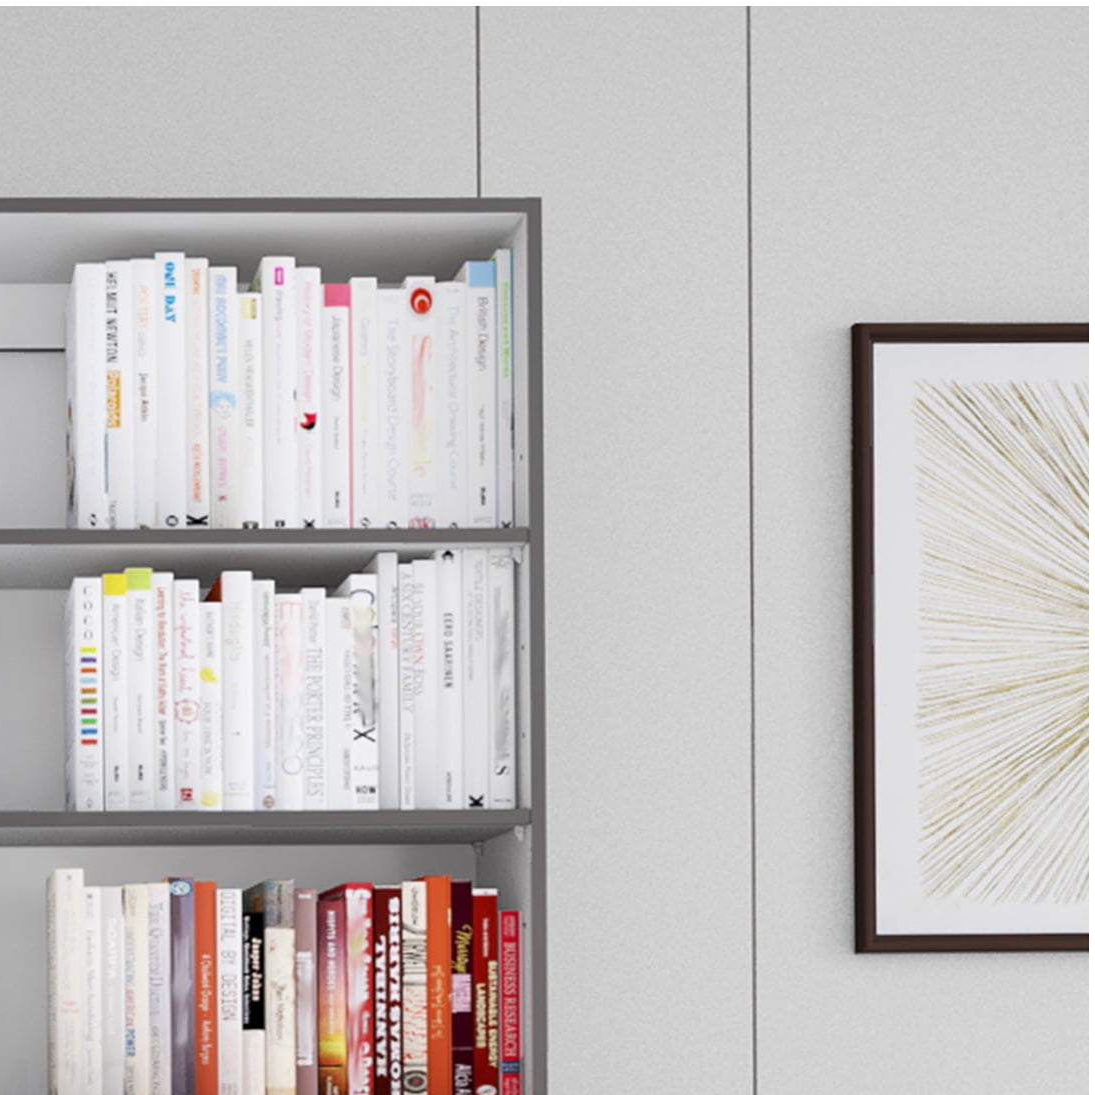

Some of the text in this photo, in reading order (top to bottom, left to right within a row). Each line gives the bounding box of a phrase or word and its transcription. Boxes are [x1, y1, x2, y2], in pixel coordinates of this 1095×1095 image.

[106, 271, 118, 363] HELMUT NEWTON
[165, 262, 176, 323] ONE DAY
[449, 306, 459, 327] The
[331, 315, 345, 363] Japanese
[477, 297, 490, 372] British Design
[331, 366, 345, 402] Design
[385, 320, 402, 502] The Storyboard Design Course
[447, 401, 459, 448] Drawing
[133, 598, 146, 663] Italian Design
[413, 633, 425, 665] OWN
[443, 612, 454, 688] EERO SAARINEN
[110, 649, 122, 682] Design
[402, 666, 414, 714] FAMILY
[305, 647, 324, 797] THE PORTER PRINCIPLES
[326, 910, 336, 940] MISFITS
[327, 942, 336, 957] AND
[388, 896, 401, 1002] HARRIS
[220, 892, 238, 1022] DIGITAL BY DESIGN
[250, 937, 263, 1002] Jasper Johns
[327, 960, 336, 990] HEROES
[503, 941, 518, 995] BUSINESS
[200, 990, 213, 1012] Orange
[376, 935, 388, 1077] HANNIBAL
[476, 983, 487, 1048] LANDSCAPES
[488, 960, 498, 1068] SUSTAINABLE ENERGY
[503, 997, 517, 1057] RESEARCH
[125, 1028, 137, 1058] POWER
